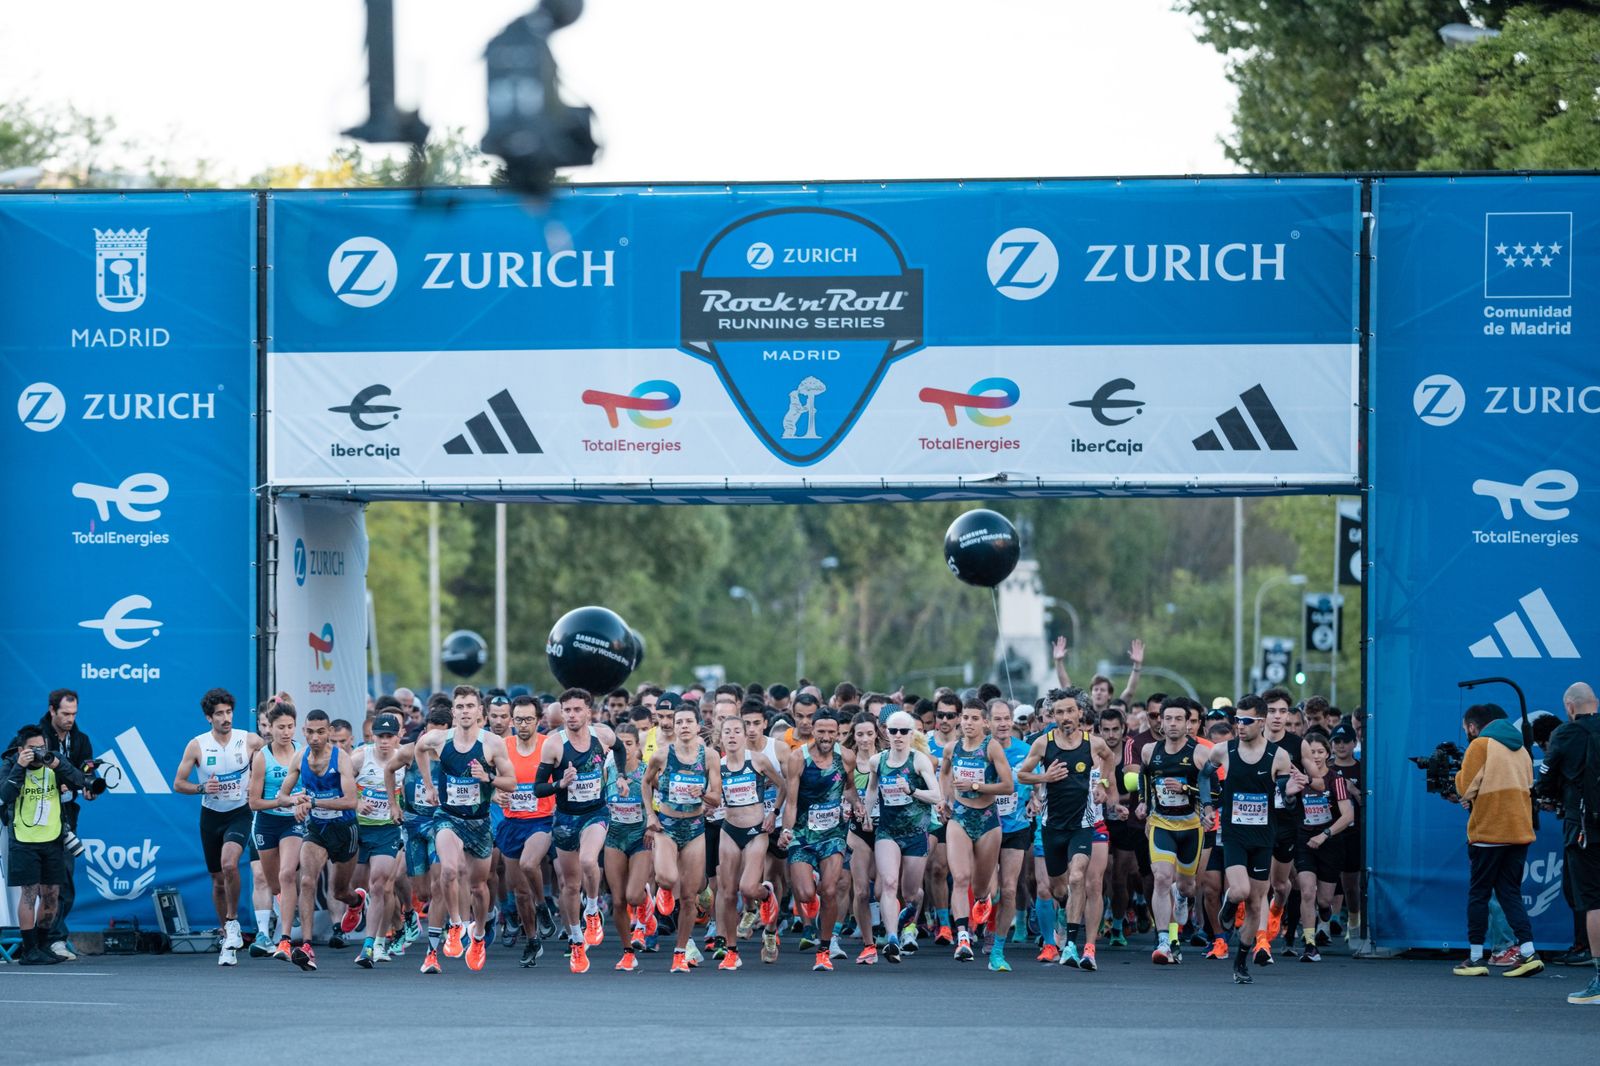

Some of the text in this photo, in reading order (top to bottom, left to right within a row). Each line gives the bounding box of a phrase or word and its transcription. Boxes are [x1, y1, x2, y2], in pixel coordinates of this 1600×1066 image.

[783, 247, 857, 263] ZURICH
[1083, 242, 1286, 283] ZURICH
[421, 250, 615, 290] ZURICH
[1483, 305, 1572, 319] Comunidad
[718, 316, 886, 330] RUNNING SERIES
[1483, 321, 1572, 336] de Madrid
[71, 327, 171, 348] MADRID
[762, 349, 841, 361] MADRID
[81, 392, 216, 420] ZURICH
[1483, 385, 1600, 414] ZURIC
[330, 442, 401, 461] iberCaja
[582, 438, 682, 455] TotalEnergies
[918, 436, 1021, 453] TotalEnergies
[1070, 437, 1144, 456] iberCaja
[71, 530, 170, 547] TotalEnergies
[1471, 529, 1579, 547] TotalEnergies
[310, 550, 344, 576] ZURICH
[572, 640, 598, 655] Galaxy
[575, 633, 610, 649] SAMSUNG
[81, 663, 161, 683] iberCaja
[217, 782, 237, 791] 0053
[456, 786, 469, 795] BEN
[575, 782, 594, 791] MAYO
[1238, 803, 1262, 813] 40213
[80, 838, 161, 877] Rock
[113, 876, 130, 890] fm
